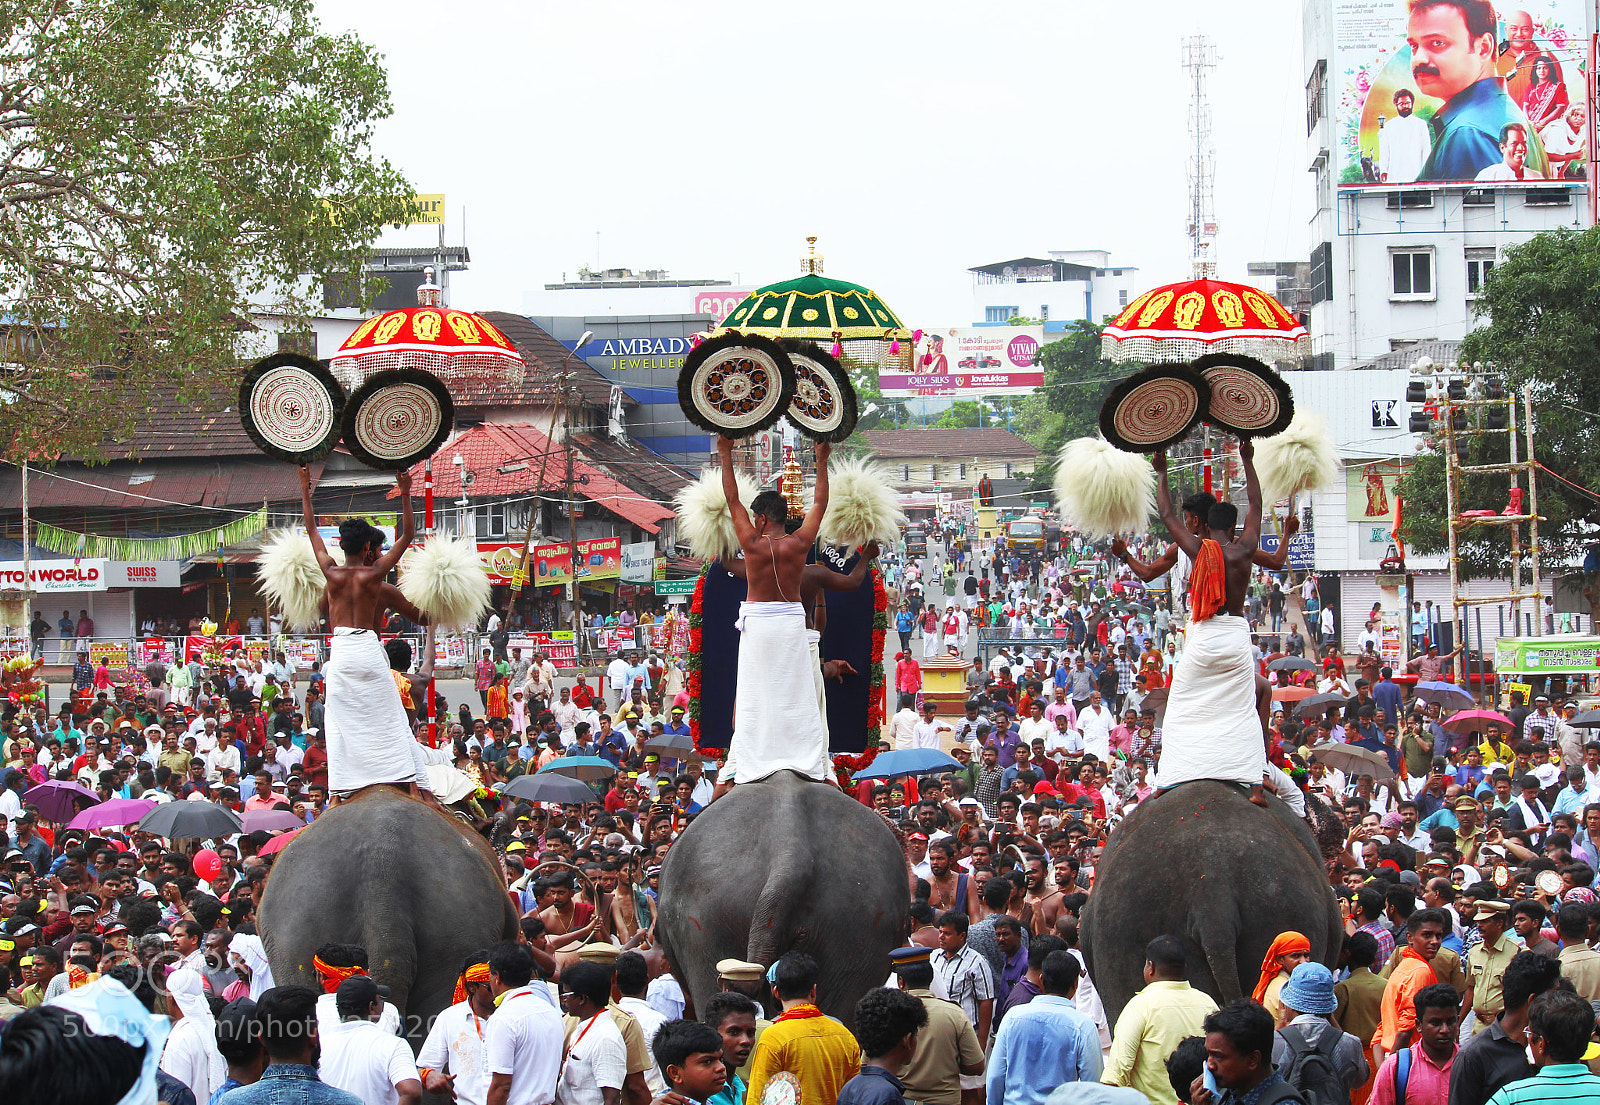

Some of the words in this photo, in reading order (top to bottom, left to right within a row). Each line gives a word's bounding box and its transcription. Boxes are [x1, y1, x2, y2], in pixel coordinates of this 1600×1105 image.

[611, 357, 684, 370] JEWELLER
[907, 376, 928, 385] JOLLY
[930, 376, 950, 384] SILKS
[38, 568, 99, 582] WORLD
[127, 566, 157, 577] SWISS
[77, 580, 98, 588] House
